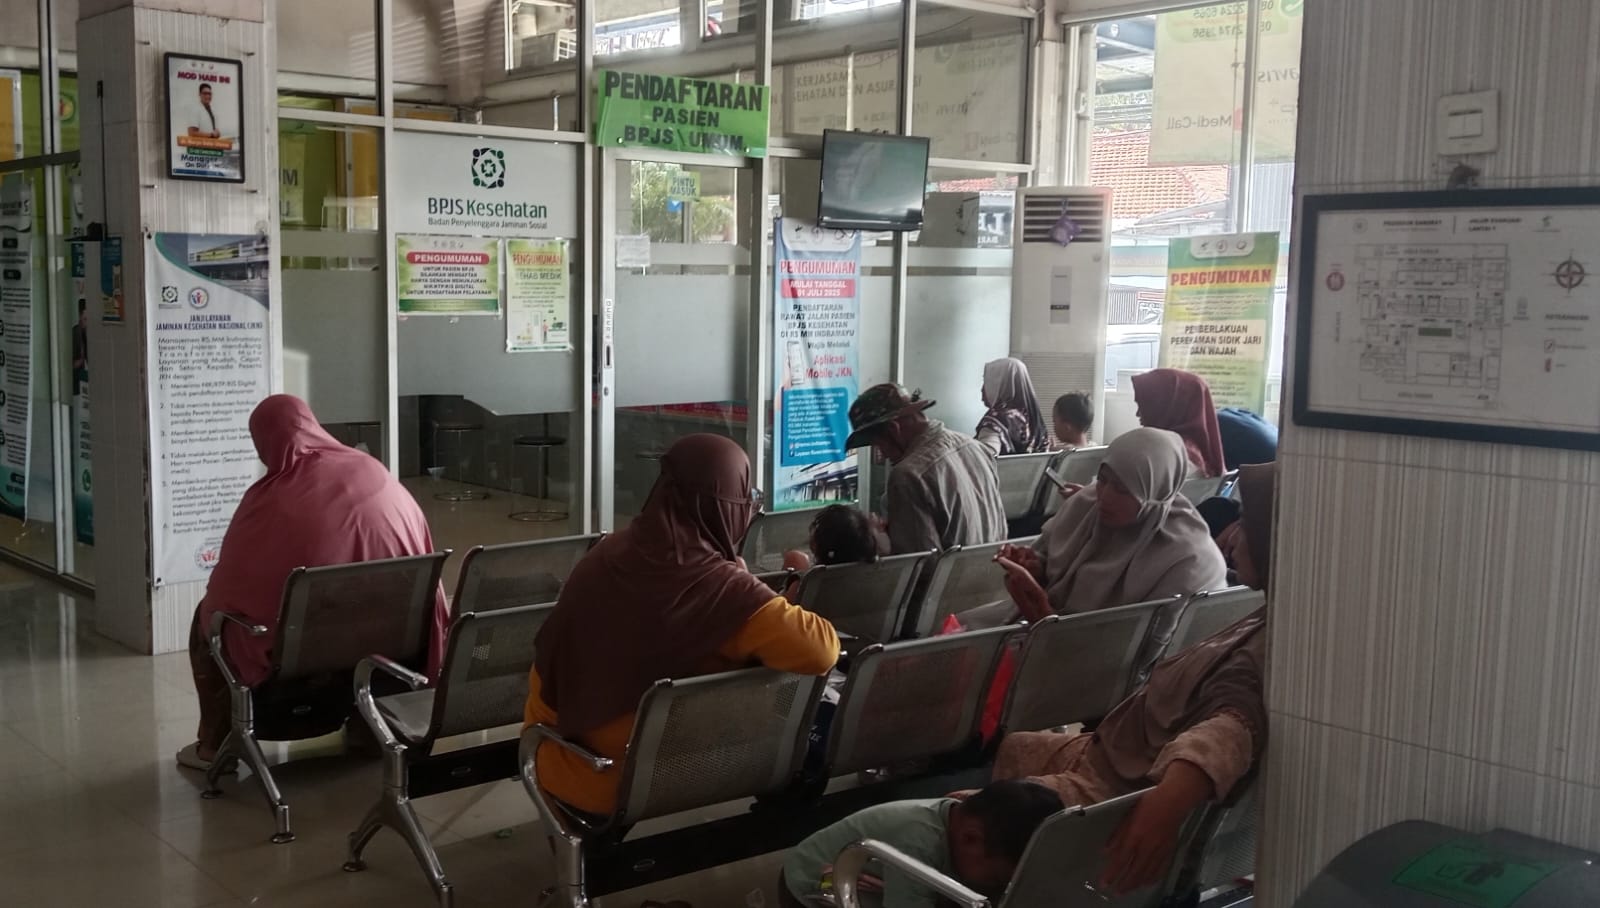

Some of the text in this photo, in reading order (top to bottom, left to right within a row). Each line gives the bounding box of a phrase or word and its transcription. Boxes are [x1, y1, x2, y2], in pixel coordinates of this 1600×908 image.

[177, 71, 197, 80] MOD
[605, 70, 763, 111] PENDAFTARAN
[652, 106, 720, 128] PASIEN
[624, 125, 674, 145] BPJS
[180, 154, 218, 163] Manager
[672, 176, 696, 187] PINTU
[671, 186, 697, 196] MASUK
[428, 197, 547, 219] BPJS Kesehatan
[428, 217, 548, 230] Badan Penyelenggara Jaminan Sosial
[414, 253, 482, 263] PENGUMUMAN
[512, 254, 562, 265] PENGUMUMAN
[780, 259, 856, 275] PENGUMUMAN
[1170, 268, 1272, 286] PENGUMUMAN
[814, 280, 847, 288] TANGGAL
[806, 288, 823, 296] JULI
[823, 288, 841, 296] 2025
[793, 303, 844, 311] PENDAFTARAN
[780, 312, 855, 320] RAWAT JALAN PASIEN
[788, 321, 848, 329] BPJS KESEHATAN
[815, 329, 855, 337] INDRAMAYU
[1170, 335, 1262, 345] PEREKAMAN SIDIK JARI
[1208, 346, 1237, 355] WAJAH
[813, 354, 846, 366] Aplikasi
[805, 367, 852, 379] Mobile JKN
